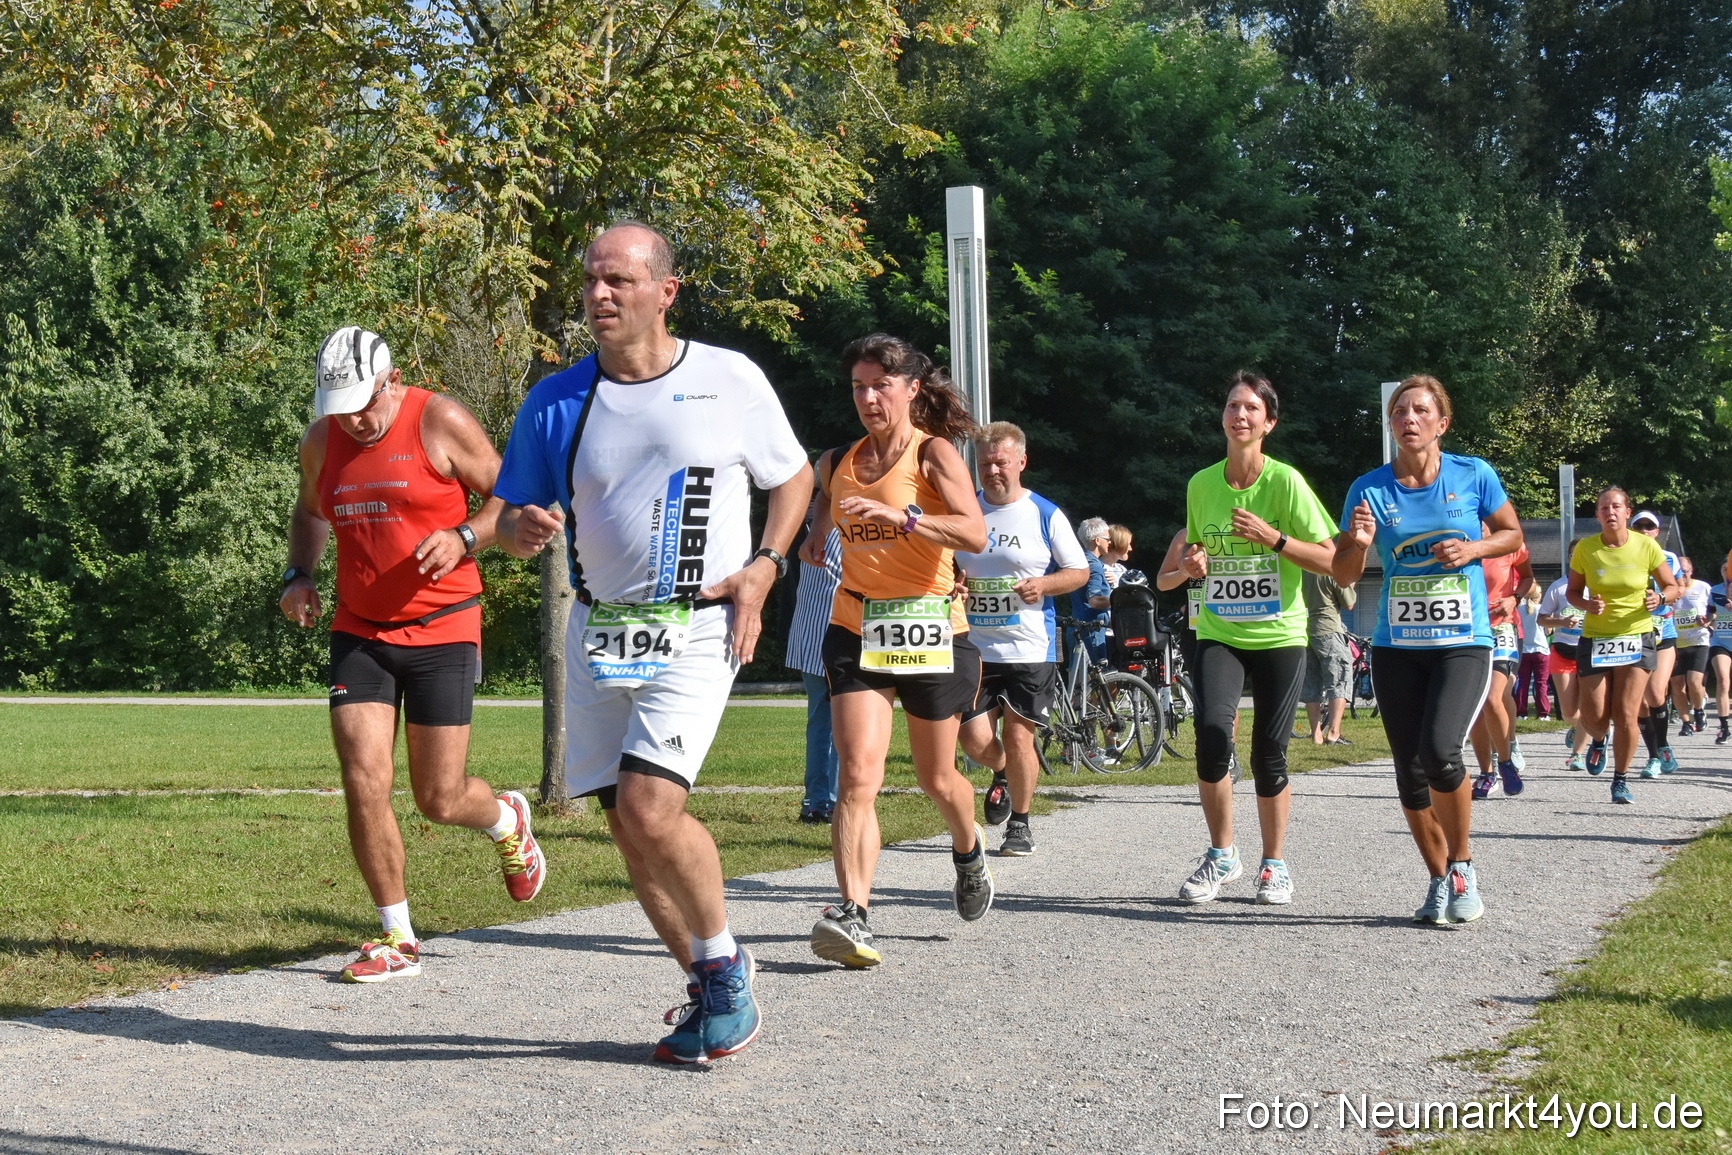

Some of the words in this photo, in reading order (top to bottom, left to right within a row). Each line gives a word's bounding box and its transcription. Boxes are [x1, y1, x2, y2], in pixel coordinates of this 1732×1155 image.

[363, 516, 402, 524] Thermostatics
[650, 498, 662, 532] WASTE
[648, 534, 659, 568] WATER
[1212, 559, 1270, 573] BOCK
[968, 581, 1010, 591] BOCK
[1212, 578, 1272, 600] 2086
[1396, 578, 1459, 593] BOCK
[871, 601, 940, 615] BOCK
[969, 596, 1011, 613] 2531
[1217, 604, 1268, 615] DANIELA
[1397, 599, 1461, 622] 2363
[974, 617, 1008, 625] ALBERT
[873, 623, 942, 647] 1303
[1402, 626, 1460, 638] BRIGITTE
[587, 628, 672, 660] 2194
[1597, 641, 1636, 655] 2214
[886, 654, 927, 665] IRENE
[591, 664, 662, 678] ERNHAR
[660, 741, 685, 755] adidas
